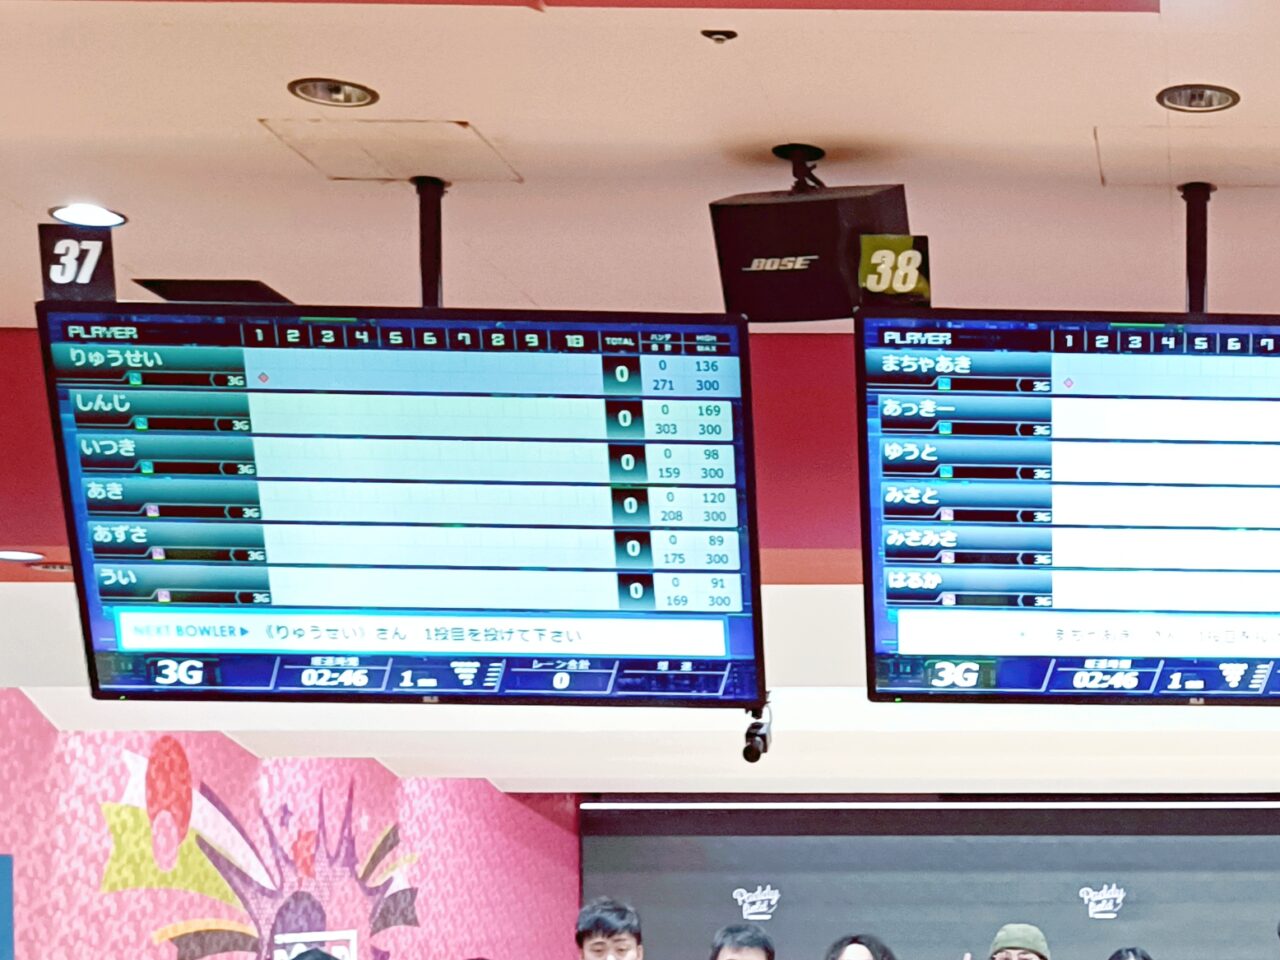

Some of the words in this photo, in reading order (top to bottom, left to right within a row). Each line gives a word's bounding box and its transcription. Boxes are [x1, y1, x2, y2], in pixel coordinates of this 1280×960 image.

[49, 239, 103, 284] 37
[741, 256, 820, 271] BOSE
[866, 249, 923, 293] 38
[67, 325, 139, 340] PLAYER
[255, 328, 264, 341] 1
[286, 330, 300, 343] 2
[321, 330, 335, 343] 3
[355, 331, 369, 343] 4
[389, 332, 403, 344] 5
[423, 333, 437, 345] 6
[525, 334, 539, 347] 9
[605, 336, 635, 346] TOTAL
[884, 332, 952, 345] PLAYER
[70, 348, 163, 367] りゅうせい
[616, 366, 629, 382] 0
[696, 361, 719, 372] 136
[227, 375, 245, 386] 3G
[653, 380, 675, 391] 271
[696, 380, 720, 392] 300
[76, 394, 131, 411] しんじ
[698, 405, 721, 416] 169
[882, 400, 956, 418] あっきー
[232, 420, 249, 430] 3G
[618, 410, 632, 427] 0
[656, 423, 678, 434] 303
[699, 424, 722, 435] 300
[81, 438, 135, 456] いつき
[704, 449, 719, 460] 98
[884, 443, 938, 461] ゆうと
[237, 464, 255, 475] 3G
[621, 454, 635, 470] 0
[658, 467, 680, 478] 159
[701, 468, 724, 479] 300
[87, 482, 123, 500] あき
[703, 492, 725, 503] 120
[885, 486, 940, 505] みさと
[242, 508, 260, 518] 3G
[624, 497, 637, 513] 0
[661, 511, 683, 521] 208
[704, 511, 726, 522] 300
[93, 525, 147, 543] あずさ
[709, 535, 724, 546] 89
[886, 529, 958, 547] みさみさ
[247, 551, 265, 561] 3G
[627, 540, 640, 556] 0
[664, 554, 685, 564] 175
[706, 553, 728, 565] 300
[100, 569, 137, 585] うい
[711, 577, 725, 588] 91
[252, 593, 270, 603] 3G
[630, 582, 643, 598] 0
[667, 596, 688, 606] 169
[708, 595, 730, 606] 300
[176, 625, 235, 638] BOWLER
[156, 660, 204, 685] 3G
[301, 668, 369, 687] 02:46
[552, 672, 571, 688] 0
[931, 662, 980, 688] 3G
[1073, 671, 1139, 689] 02:46
